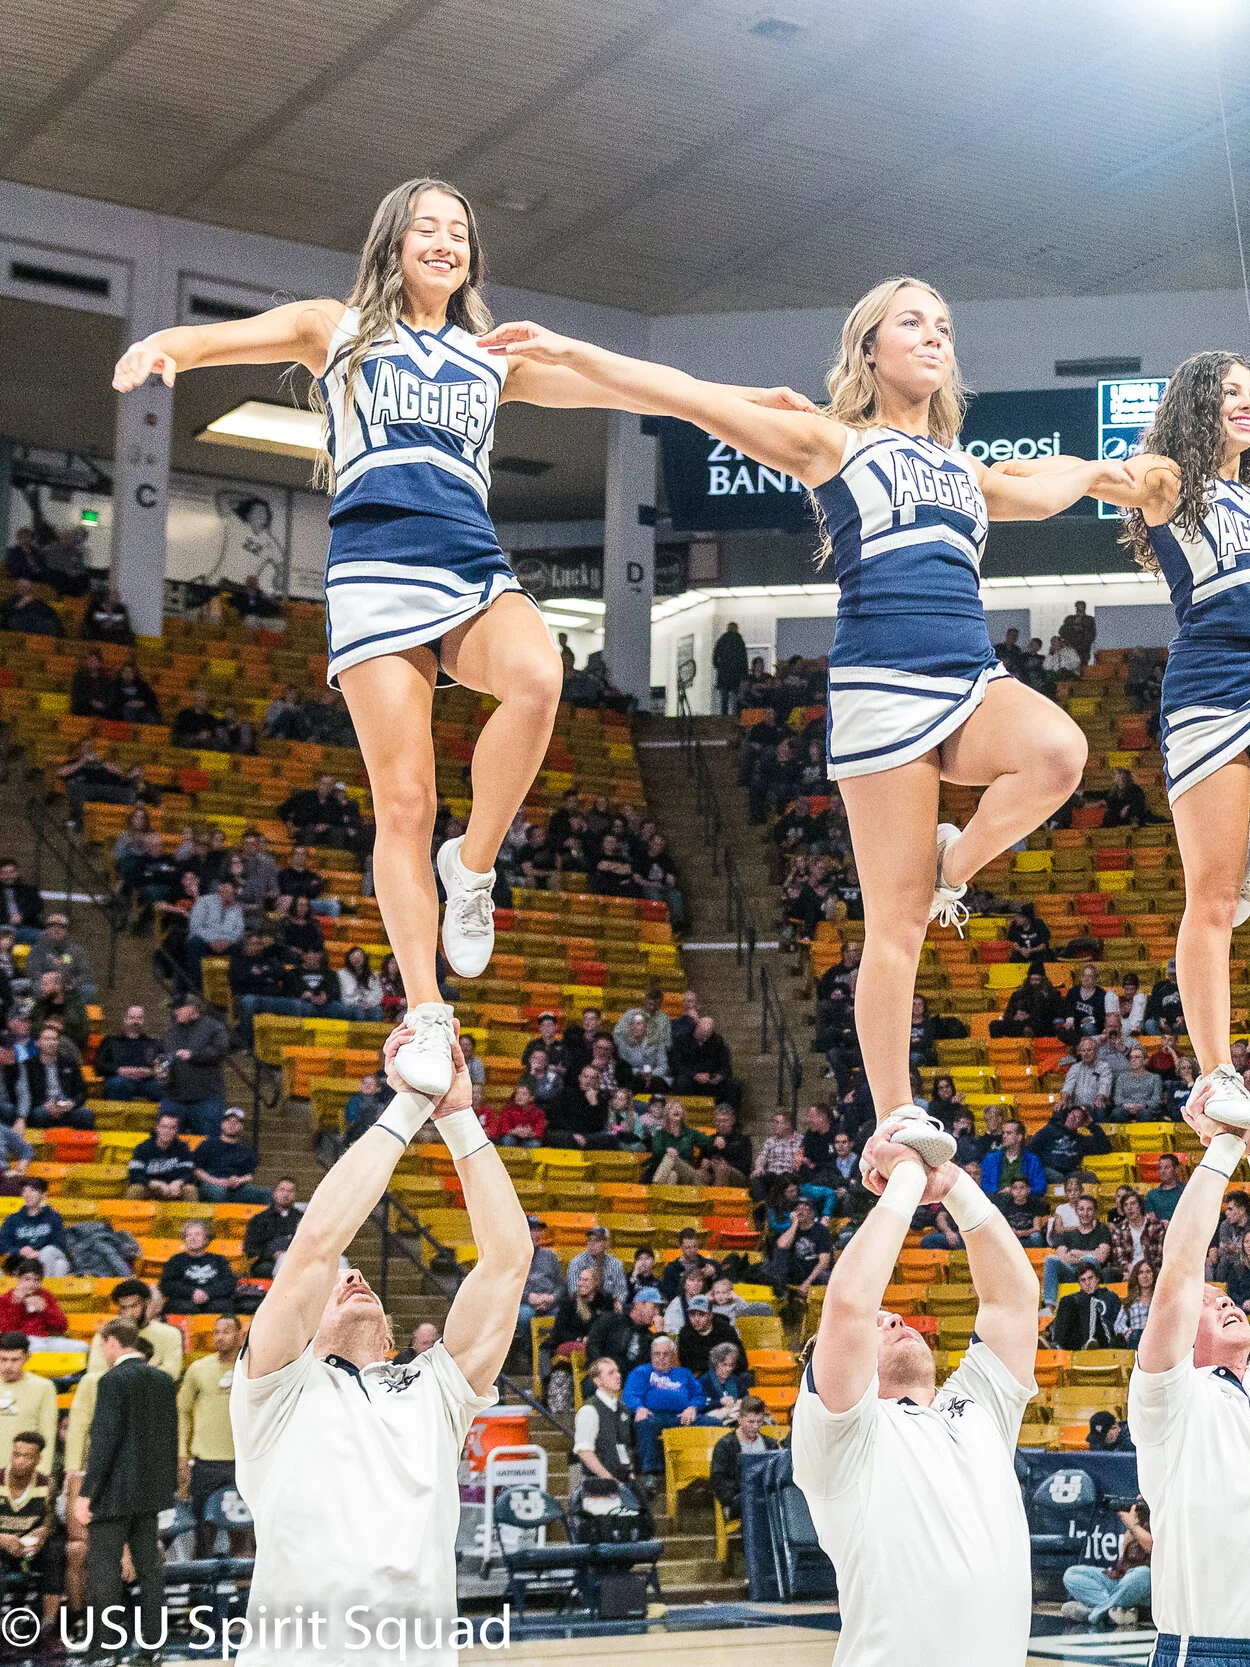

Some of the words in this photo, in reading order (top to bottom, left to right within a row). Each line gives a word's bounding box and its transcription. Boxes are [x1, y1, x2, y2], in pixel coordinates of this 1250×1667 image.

[370, 360, 489, 446] AGGIES
[136, 483, 158, 508] C
[626, 561, 644, 583] D
